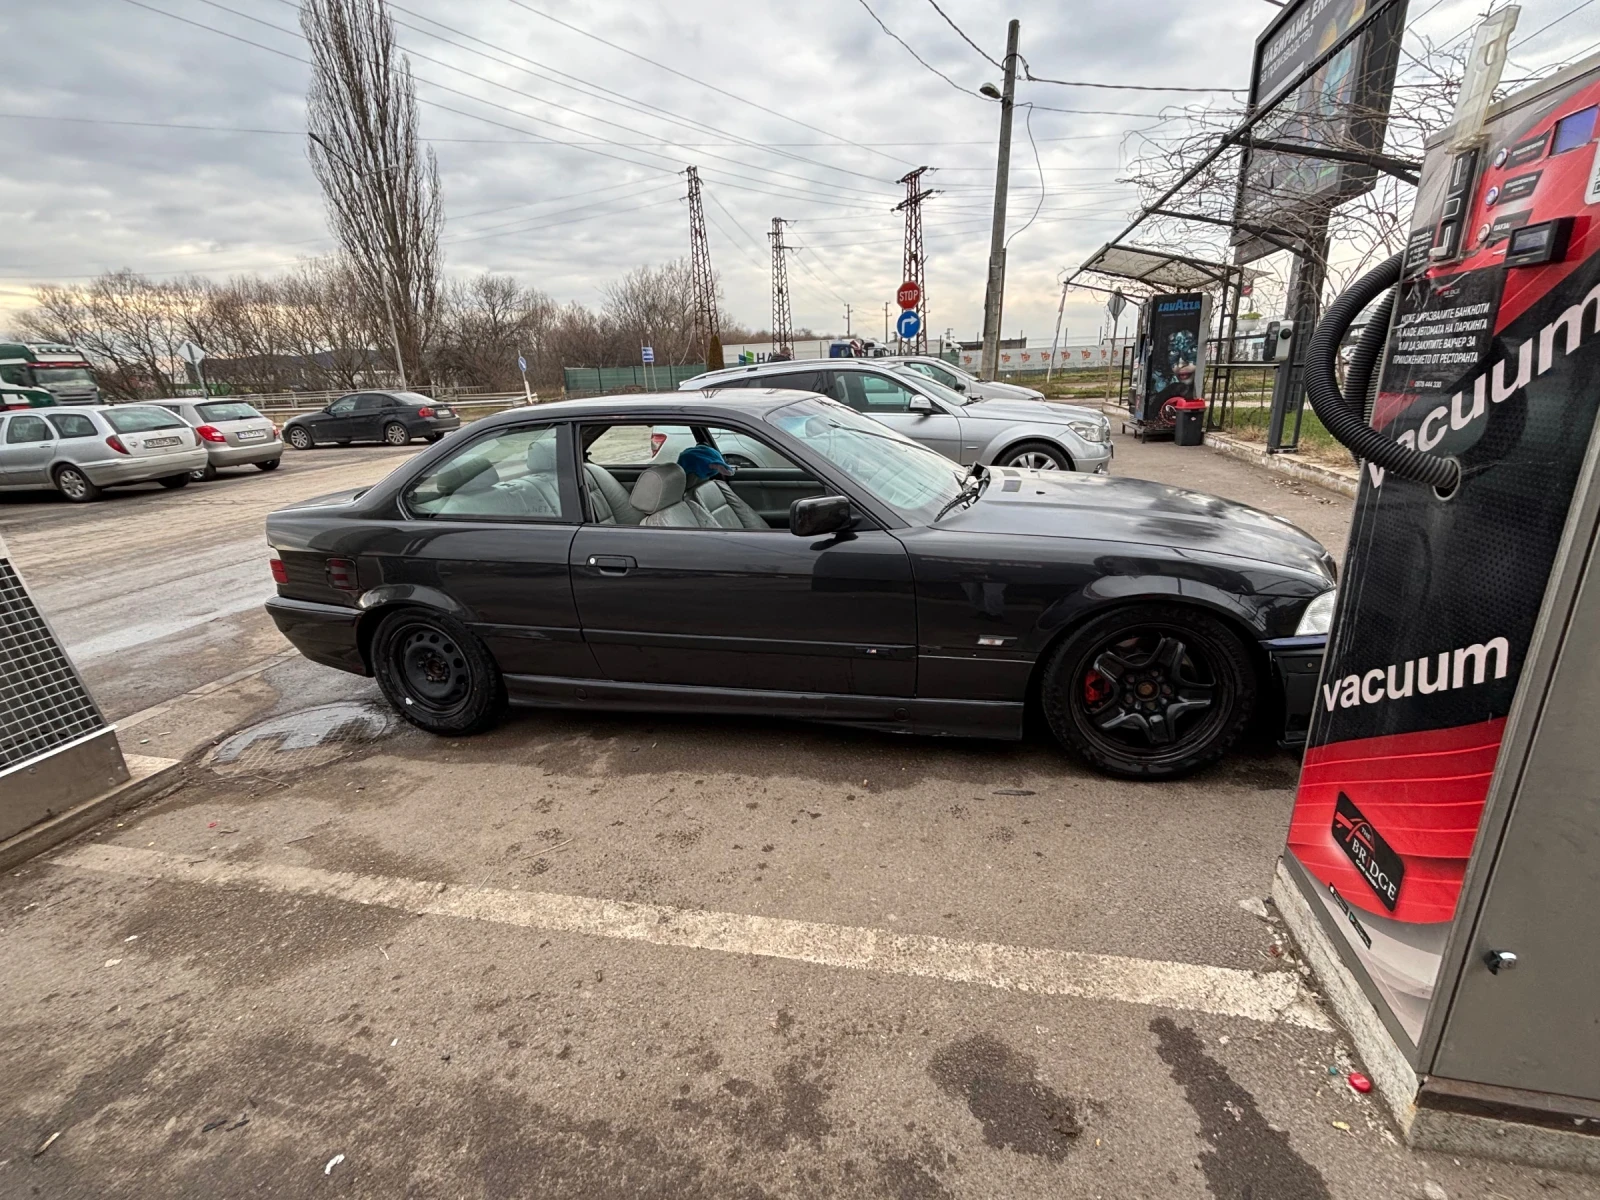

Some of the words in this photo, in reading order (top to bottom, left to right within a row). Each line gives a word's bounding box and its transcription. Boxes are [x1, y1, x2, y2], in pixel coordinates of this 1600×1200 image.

[1262, 7, 1311, 71] НАБИРАМЕ
[900, 289, 919, 302] STOP
[1157, 298, 1201, 313] LAVAZZA
[1454, 302, 1490, 318] БАНКНОТИ
[1416, 324, 1444, 335] АВТОМАТА
[1445, 323, 1453, 333] НА
[1453, 319, 1488, 332] ПАРКИНГА
[1443, 336, 1466, 348] ВАУЧЕР
[1466, 335, 1477, 347] ЗА
[1431, 354, 1440, 364] ОТ
[1439, 352, 1479, 364] РЕСТОРАНТА
[1323, 636, 1509, 712] vacuum
[1361, 827, 1371, 841] THE
